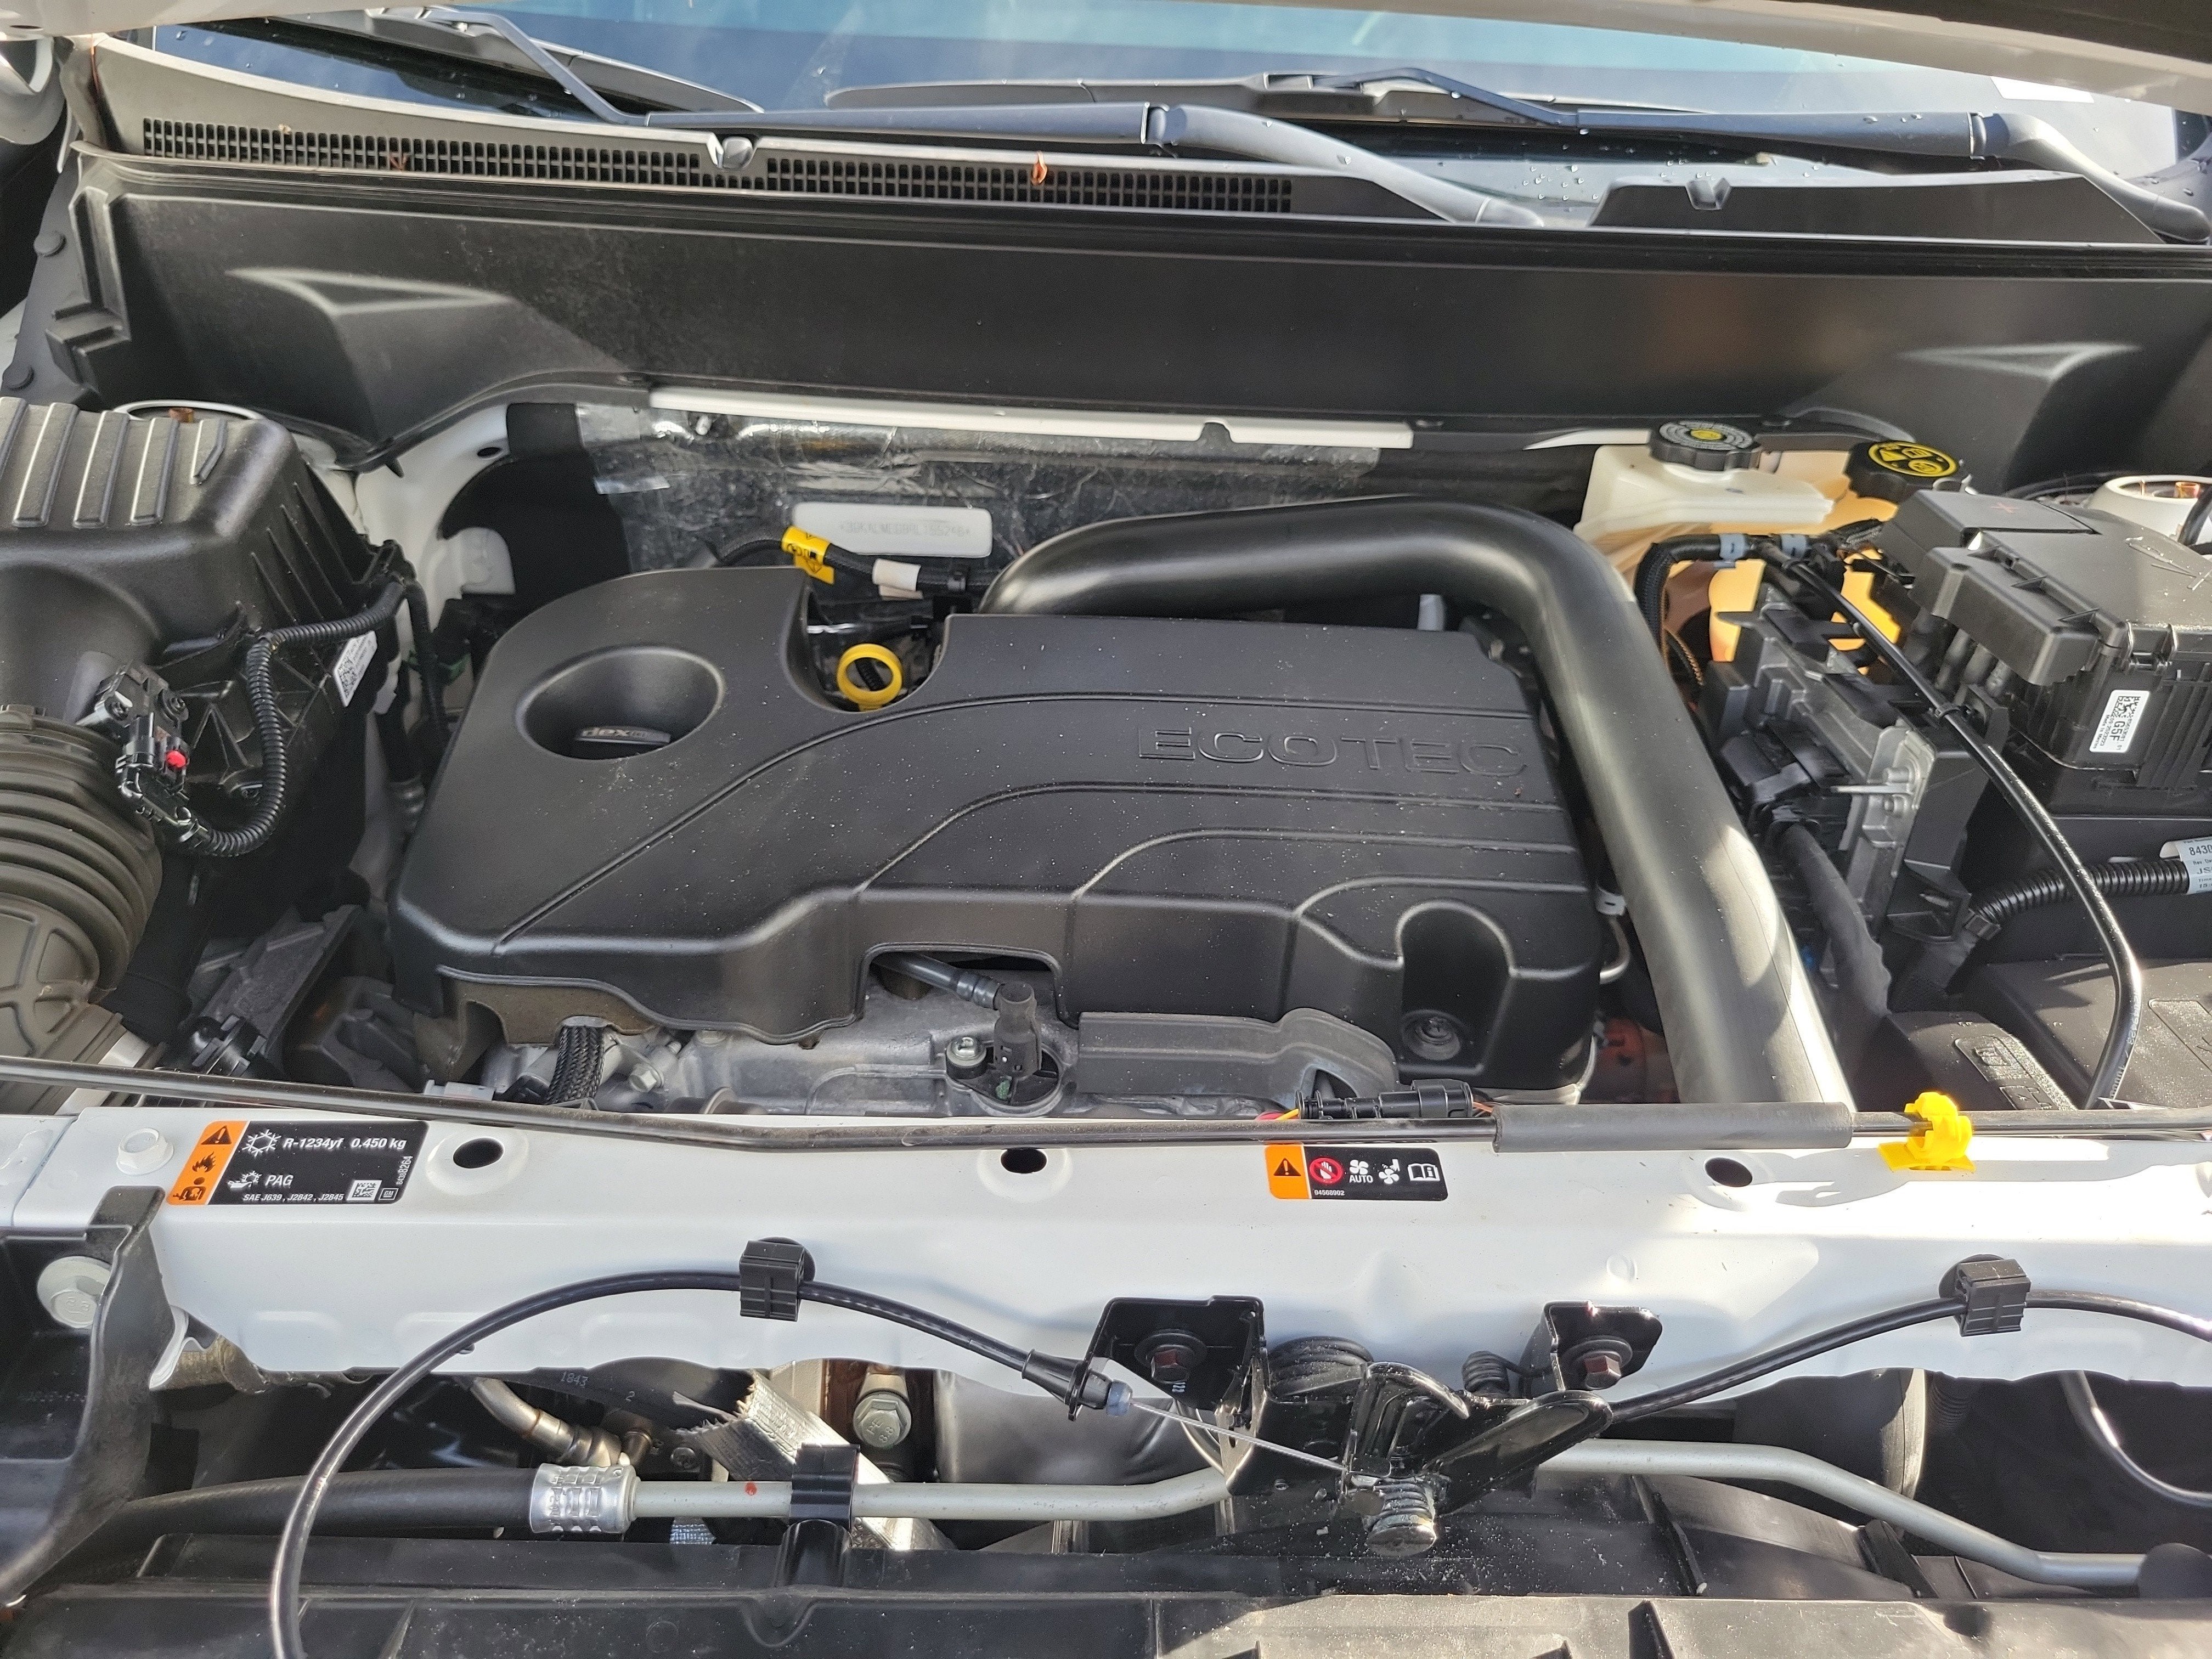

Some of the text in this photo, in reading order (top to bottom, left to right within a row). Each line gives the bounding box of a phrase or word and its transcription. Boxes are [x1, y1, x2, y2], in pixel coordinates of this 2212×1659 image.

[2109, 720, 2126, 741] G5F
[1138, 726, 1528, 777] ECOTEC
[2197, 866, 2212, 874] JS
[283, 1137, 407, 1150] R-1234yf 0.450 kg
[265, 1175, 294, 1187] PAG
[1349, 1174, 1374, 1184] AUTO
